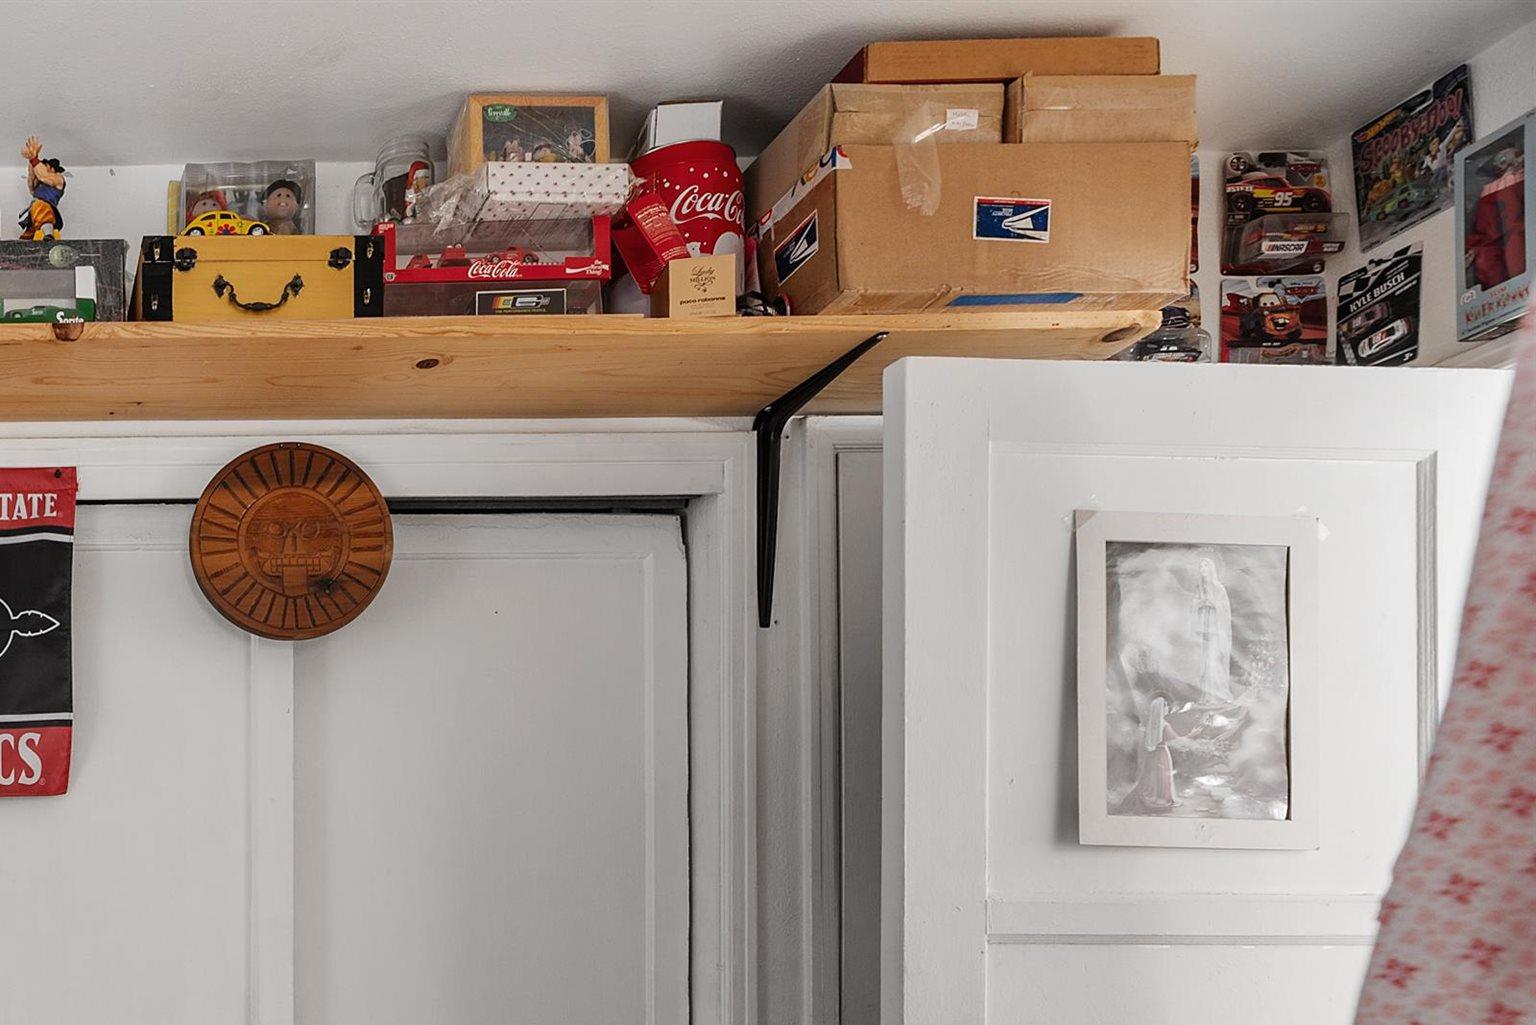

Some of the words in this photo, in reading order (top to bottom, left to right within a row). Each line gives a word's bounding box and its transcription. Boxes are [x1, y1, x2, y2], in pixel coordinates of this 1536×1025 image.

[1274, 191, 1293, 207] 95
[1272, 243, 1306, 252] NASCAR
[468, 260, 518, 279] Coca-Cola
[1350, 293, 1373, 312] KYLE
[1373, 272, 1405, 298] BUSCH
